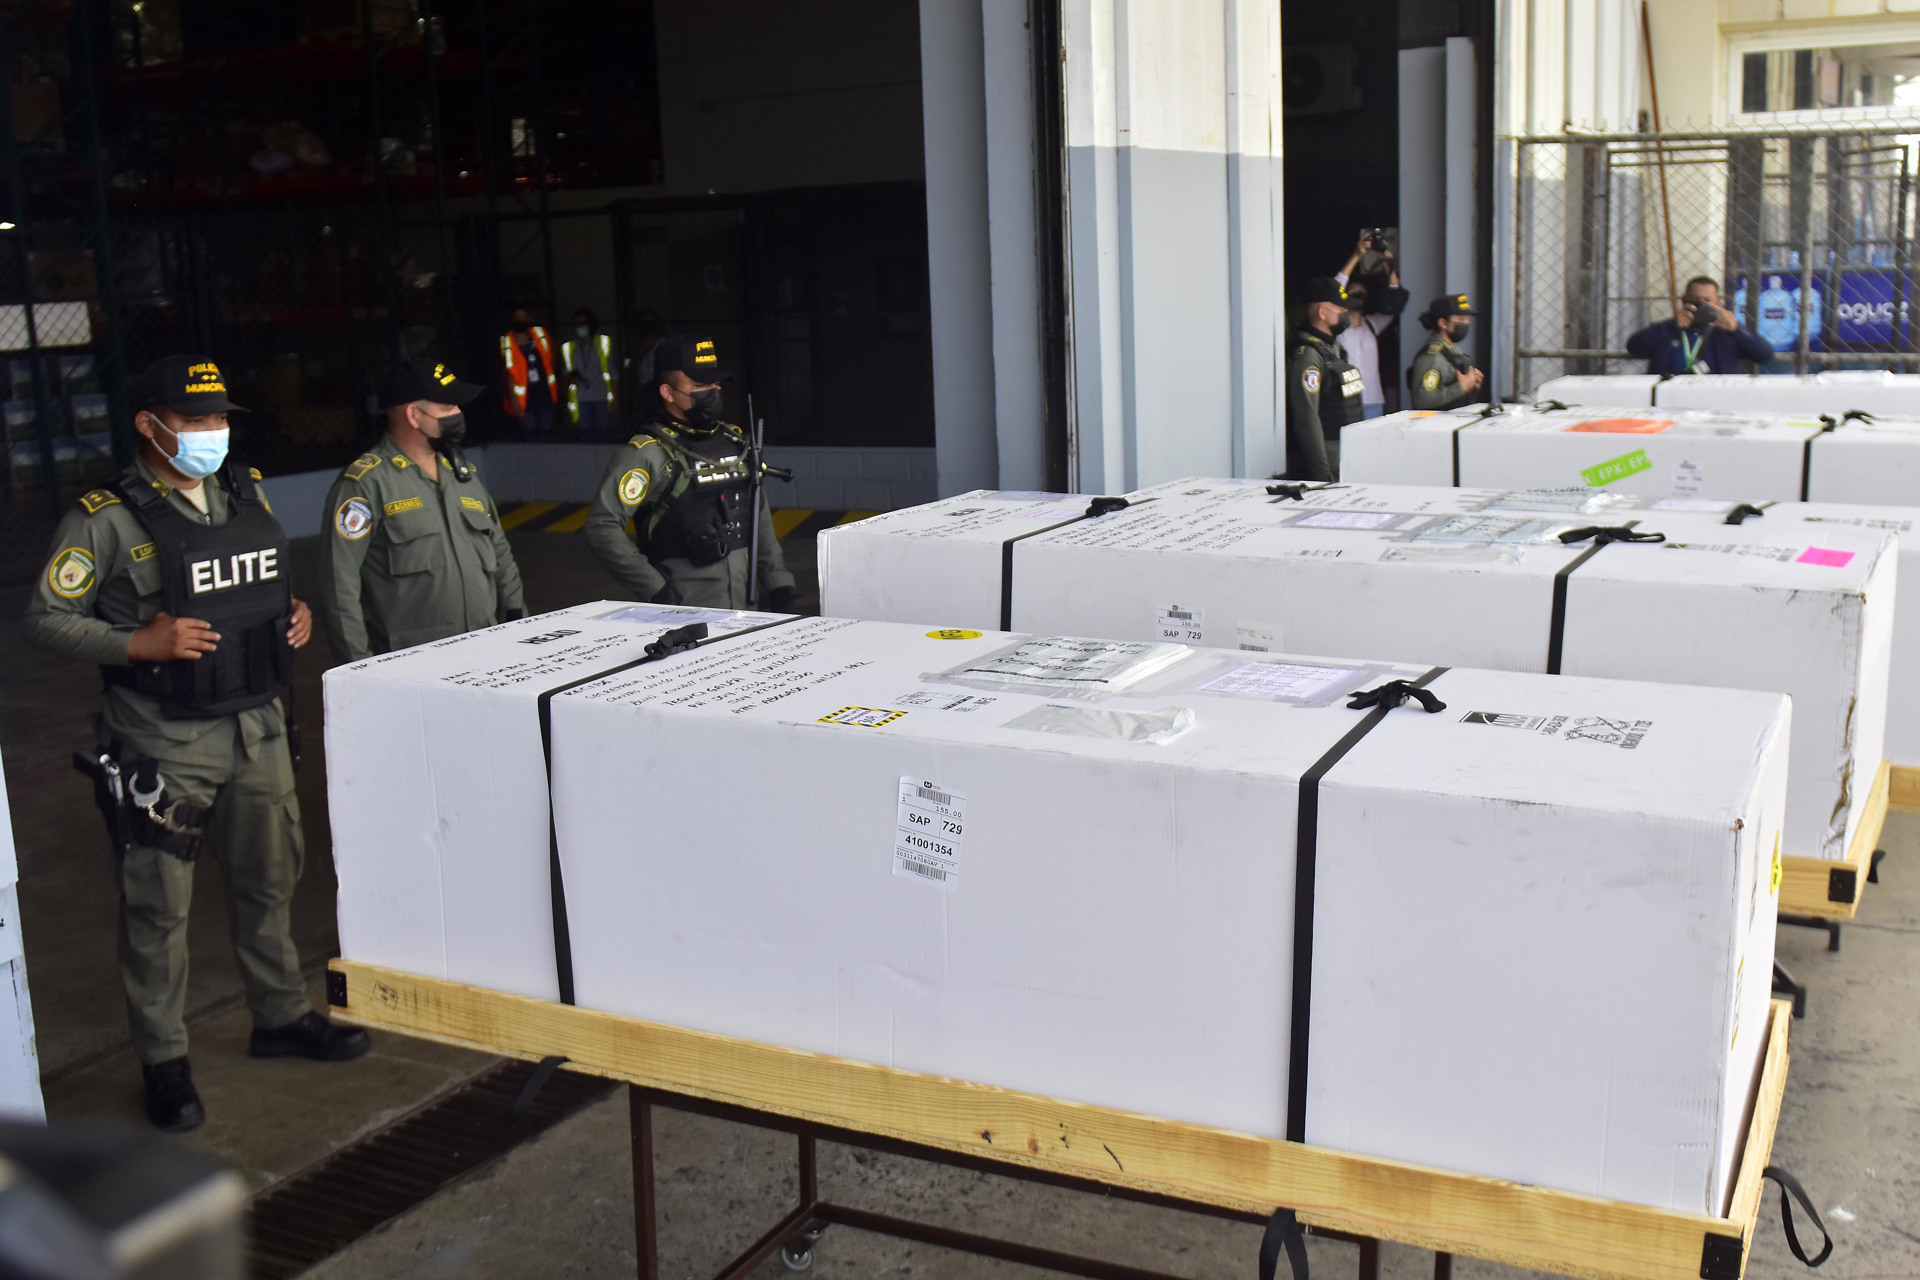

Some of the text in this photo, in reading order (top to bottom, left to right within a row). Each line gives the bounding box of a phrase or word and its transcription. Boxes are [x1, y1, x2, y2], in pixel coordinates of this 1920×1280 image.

[1598, 463, 1624, 480] EPX
[192, 548, 278, 594] ELITE
[516, 629, 583, 645] HEAD
[1163, 629, 1202, 640] SAP 729
[936, 806, 961, 818] 155.00
[909, 813, 962, 835] SAP 729
[905, 835, 952, 856] 41001354
